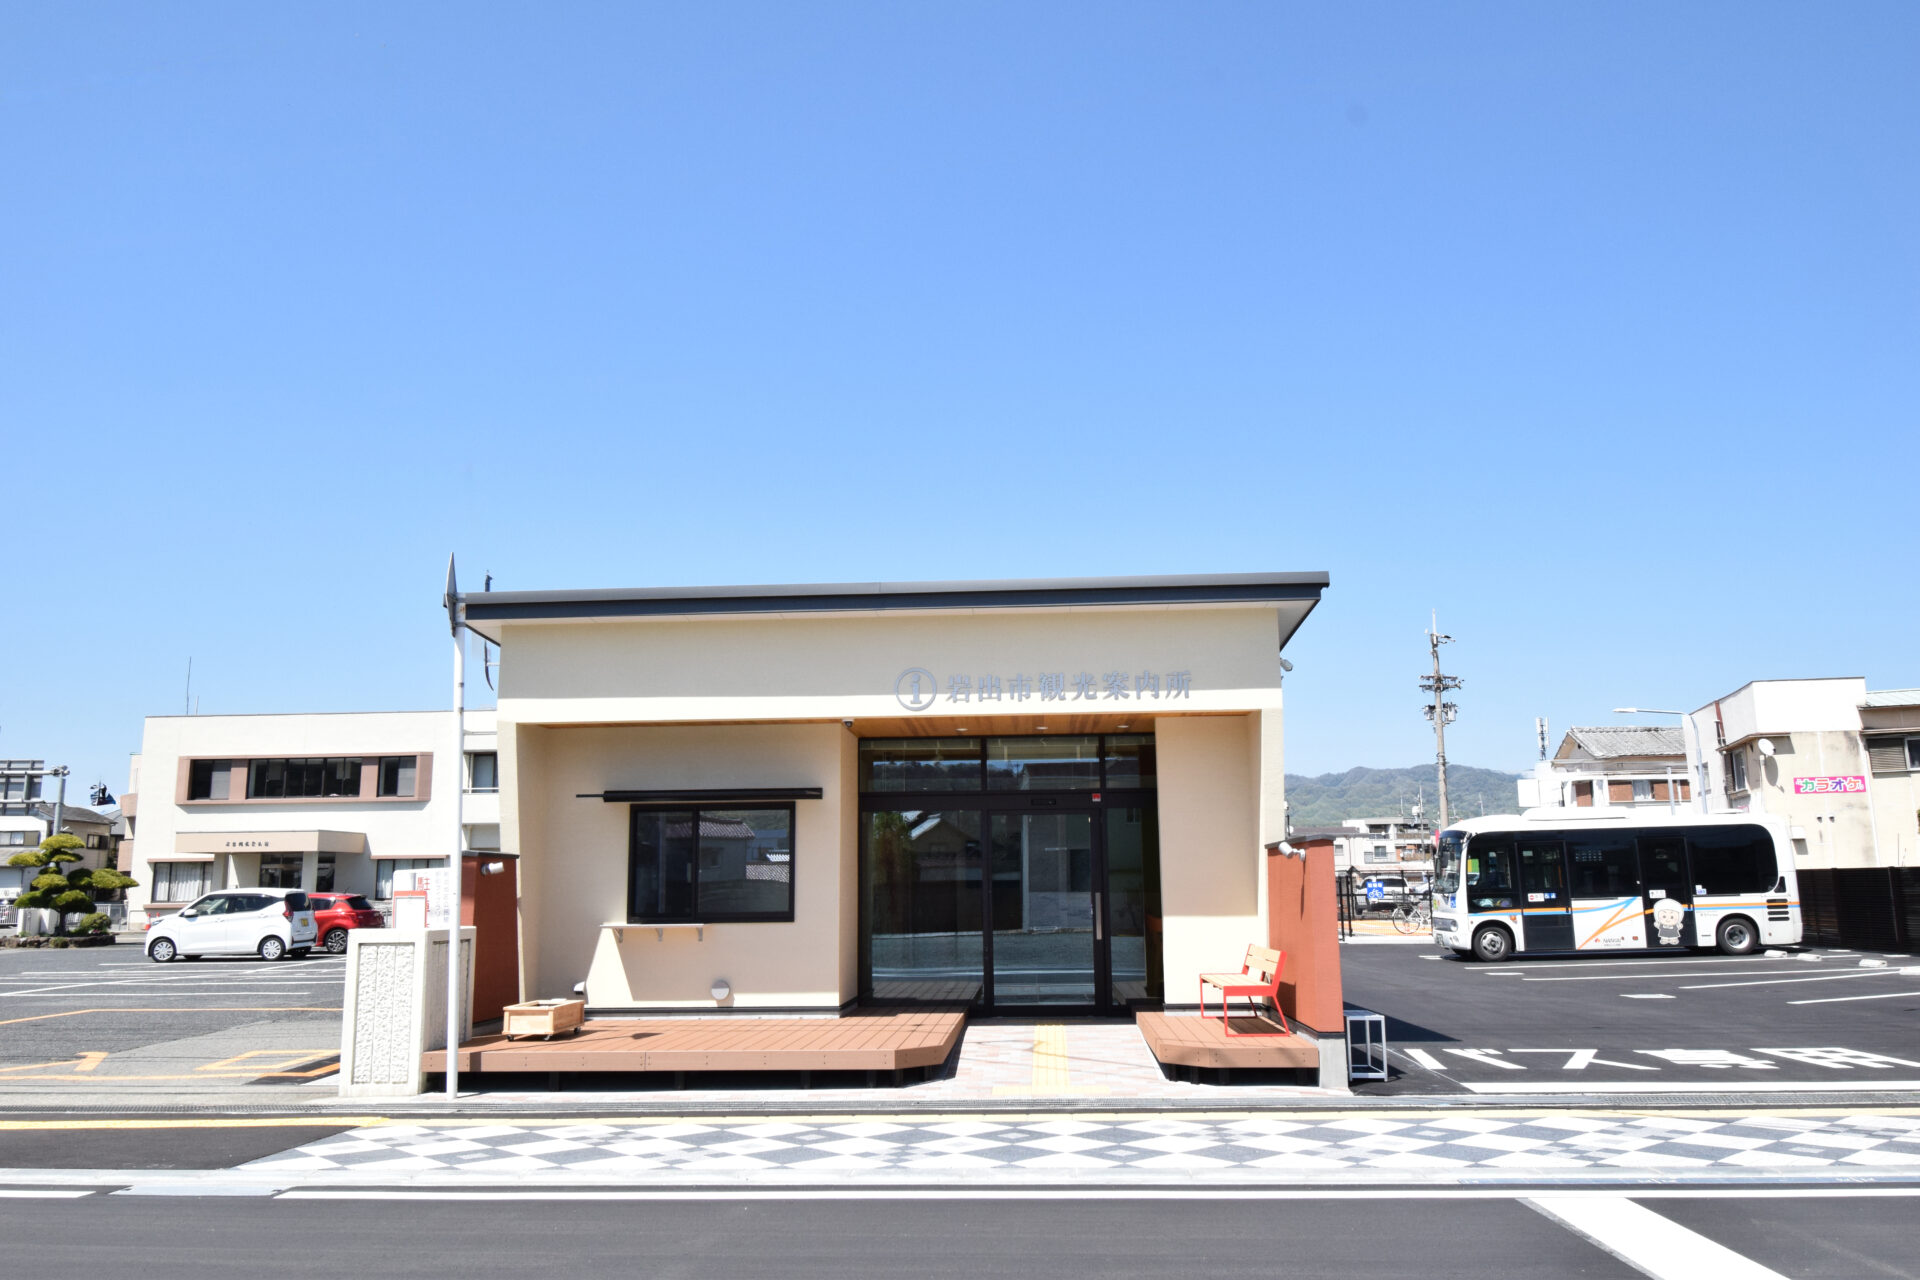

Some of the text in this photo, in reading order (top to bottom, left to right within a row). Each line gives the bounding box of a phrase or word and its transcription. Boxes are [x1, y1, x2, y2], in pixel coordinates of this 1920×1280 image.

[945, 670, 1193, 704] 岩出市観光案内所
[1801, 777, 1861, 792] カラオケ
[1403, 1047, 1920, 1071] バス専用
